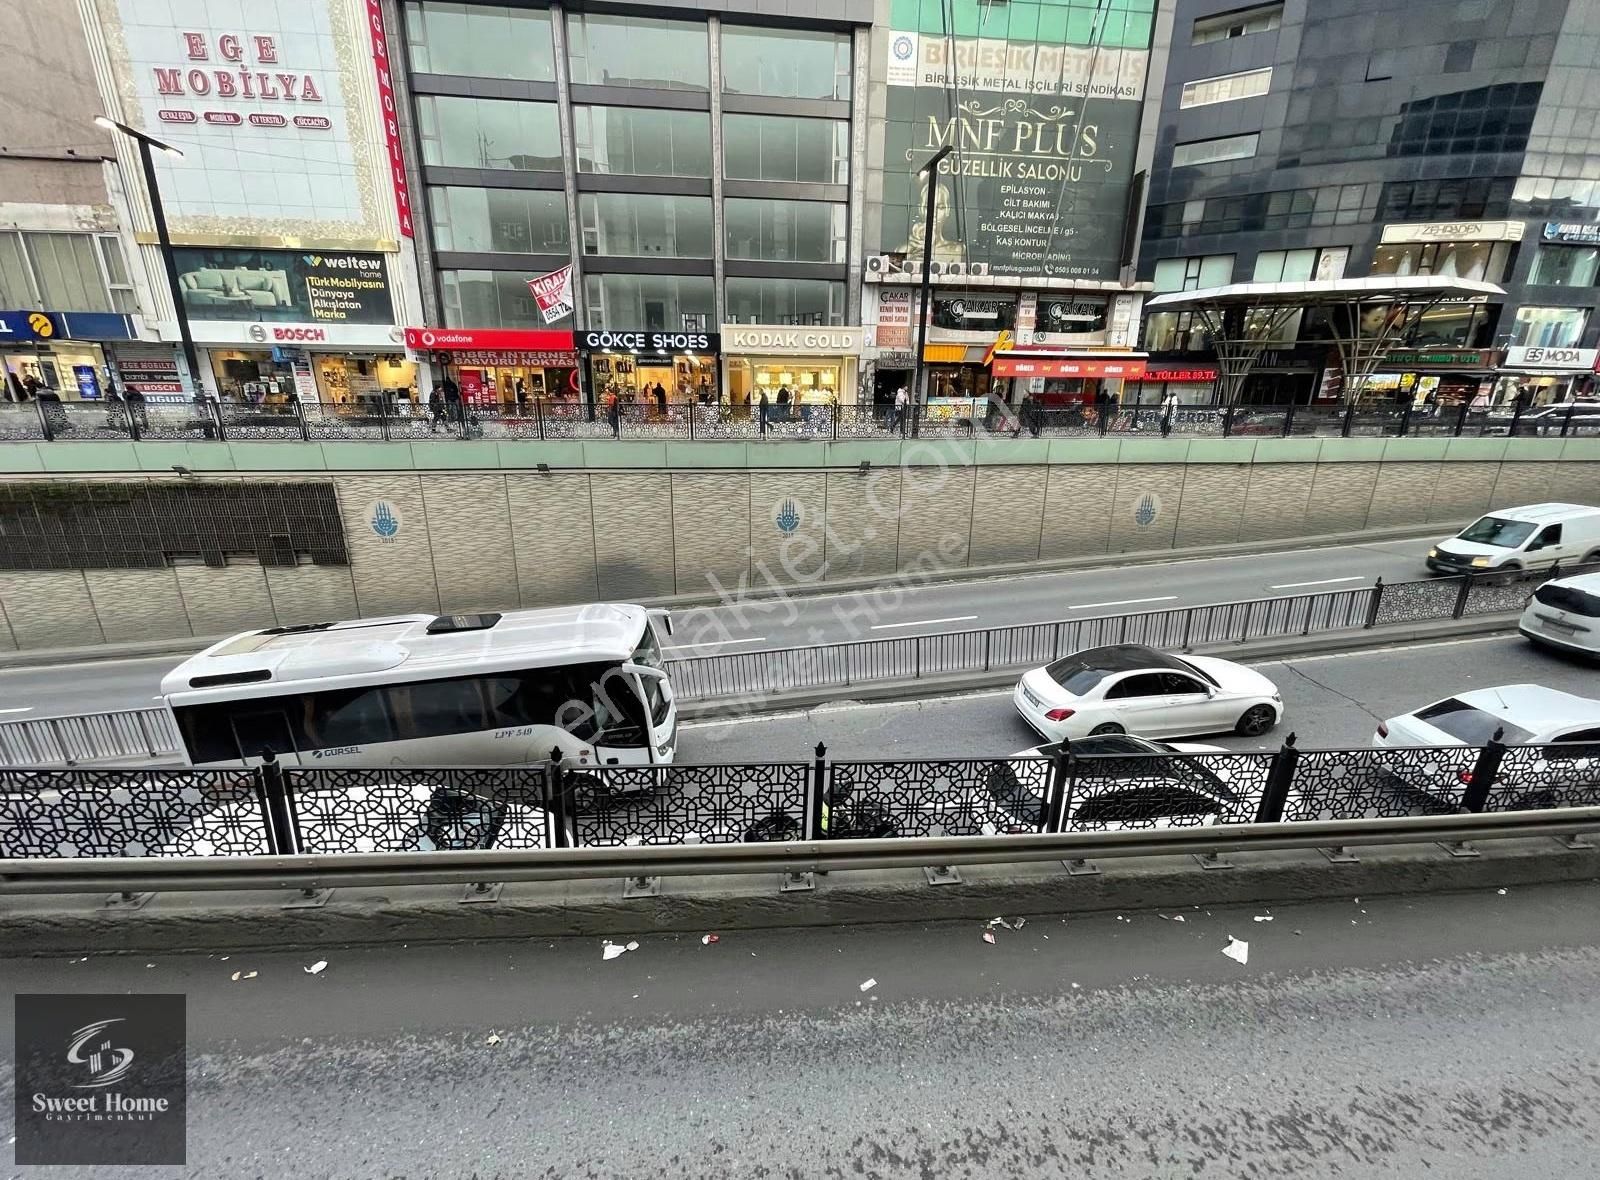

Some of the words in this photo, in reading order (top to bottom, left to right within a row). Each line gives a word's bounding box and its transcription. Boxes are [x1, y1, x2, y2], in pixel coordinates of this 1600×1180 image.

[183, 32, 278, 63] EGE
[153, 64, 322, 101] MOBİLYA
[925, 71, 979, 86] BİRLEŞİK
[983, 76, 1021, 89] METAL
[1076, 82, 1136, 97] SENDİKASI
[925, 115, 1004, 150] MNF
[1009, 121, 1099, 157] PLUS
[937, 156, 1012, 178] GÜZELLİK
[1017, 162, 1082, 182] SALONU
[1000, 184, 1046, 195] EPİLASYON
[1023, 200, 1050, 209] BAKIMI
[1014, 239, 1047, 247] KONTUR
[324, 256, 381, 270] weltew
[308, 276, 330, 287] Türk
[360, 271, 382, 279] home
[311, 288, 355, 300] Dünyaya
[880, 291, 909, 304] ÇAKAR
[314, 299, 362, 310] Alkışlatan
[315, 310, 347, 319] Marka
[273, 327, 325, 342] BOSCH
[437, 335, 473, 343] vodafone
[586, 331, 646, 350] GÖKÇE
[653, 333, 709, 349] SHOES
[734, 333, 799, 348] KODAK
[805, 334, 854, 348] GOLD
[1525, 348, 1542, 361] ES
[1544, 350, 1580, 362] MODA
